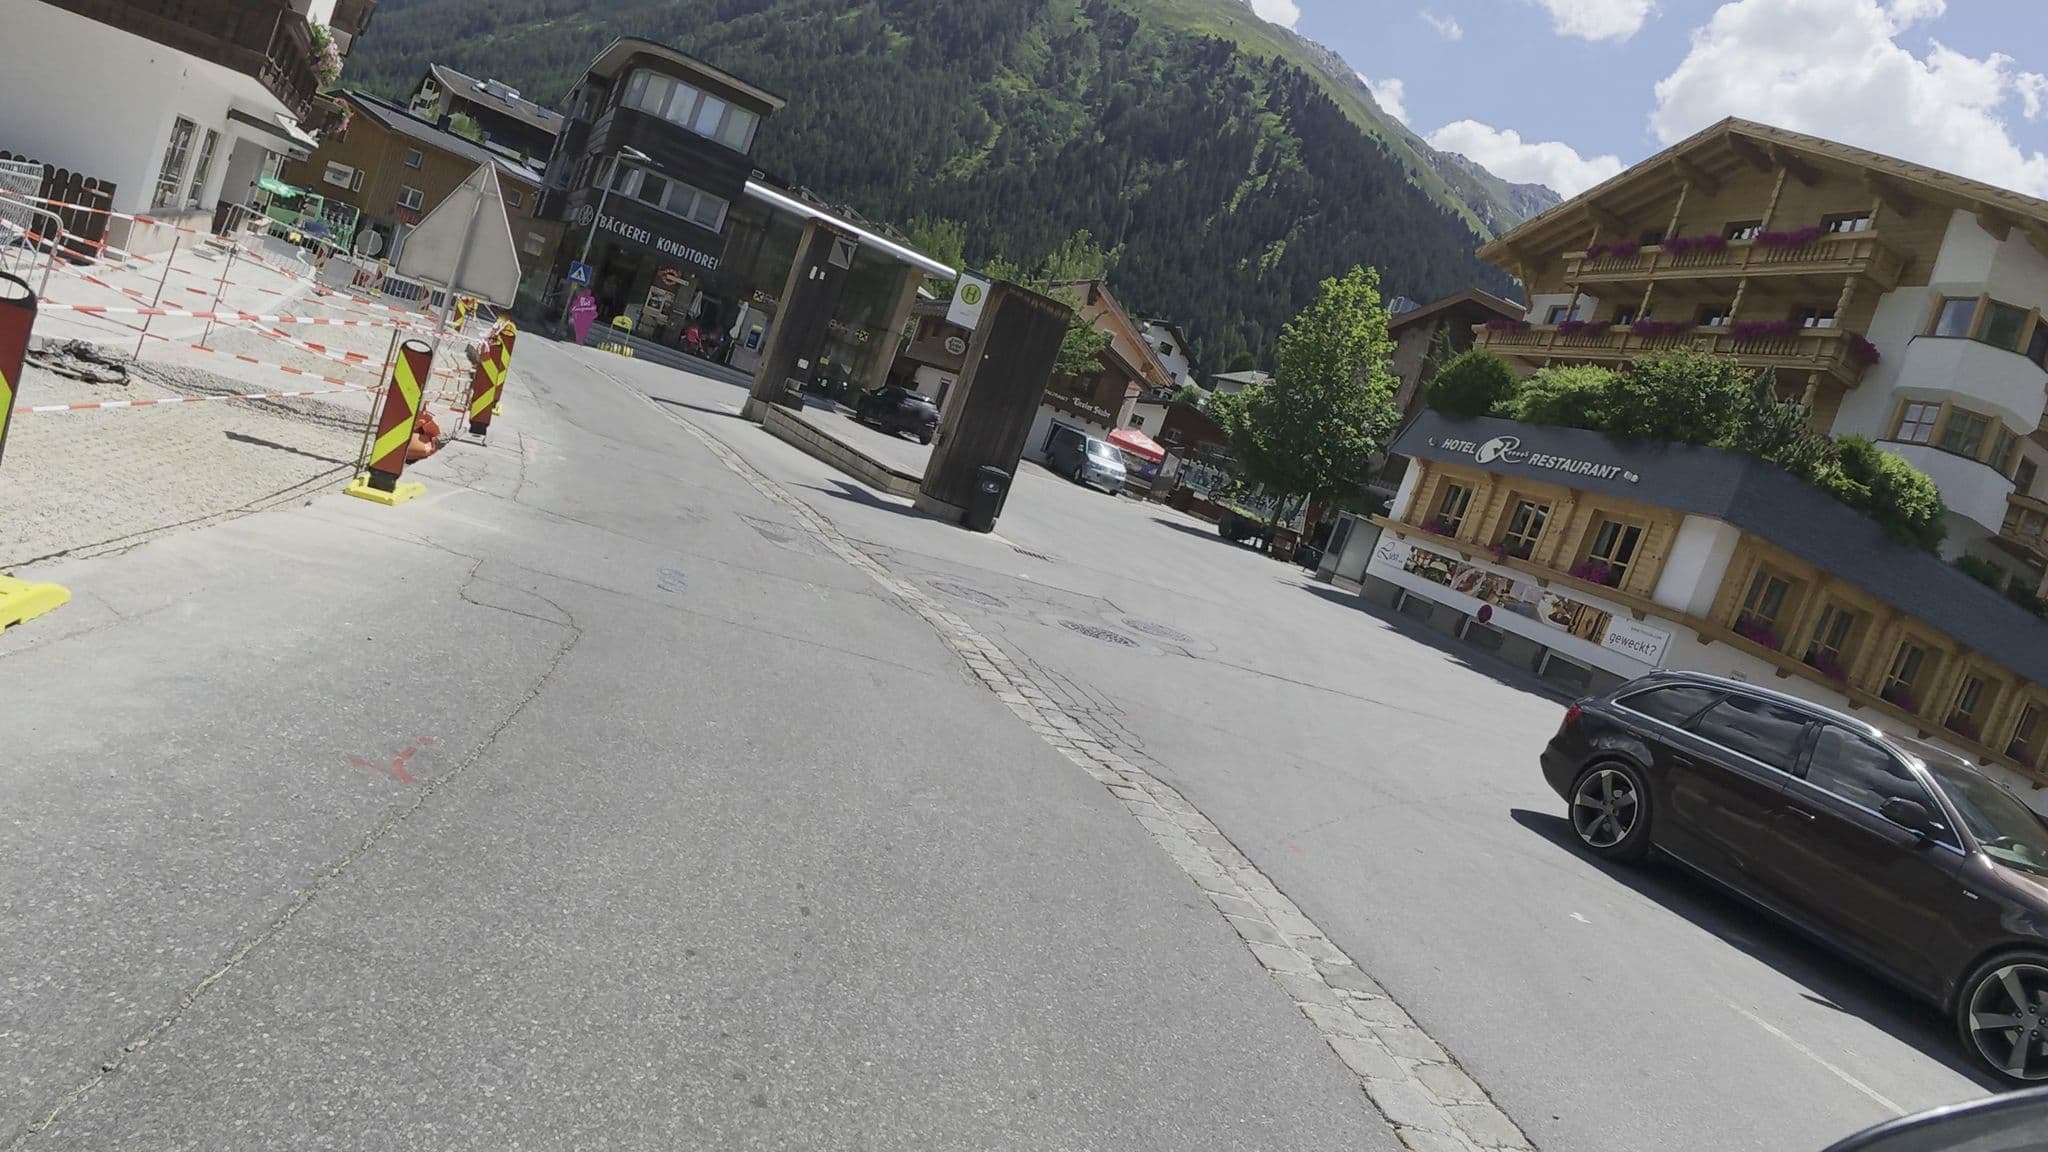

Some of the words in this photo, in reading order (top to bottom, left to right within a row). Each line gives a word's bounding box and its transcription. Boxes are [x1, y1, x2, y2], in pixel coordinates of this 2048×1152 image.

[599, 214, 651, 245] BÄCKEREI
[656, 236, 719, 271] KONDITOREI
[1441, 438, 1477, 454] HOTEL
[1528, 453, 1621, 479] RESTAURANT
[1609, 632, 1657, 656] geweckt?
